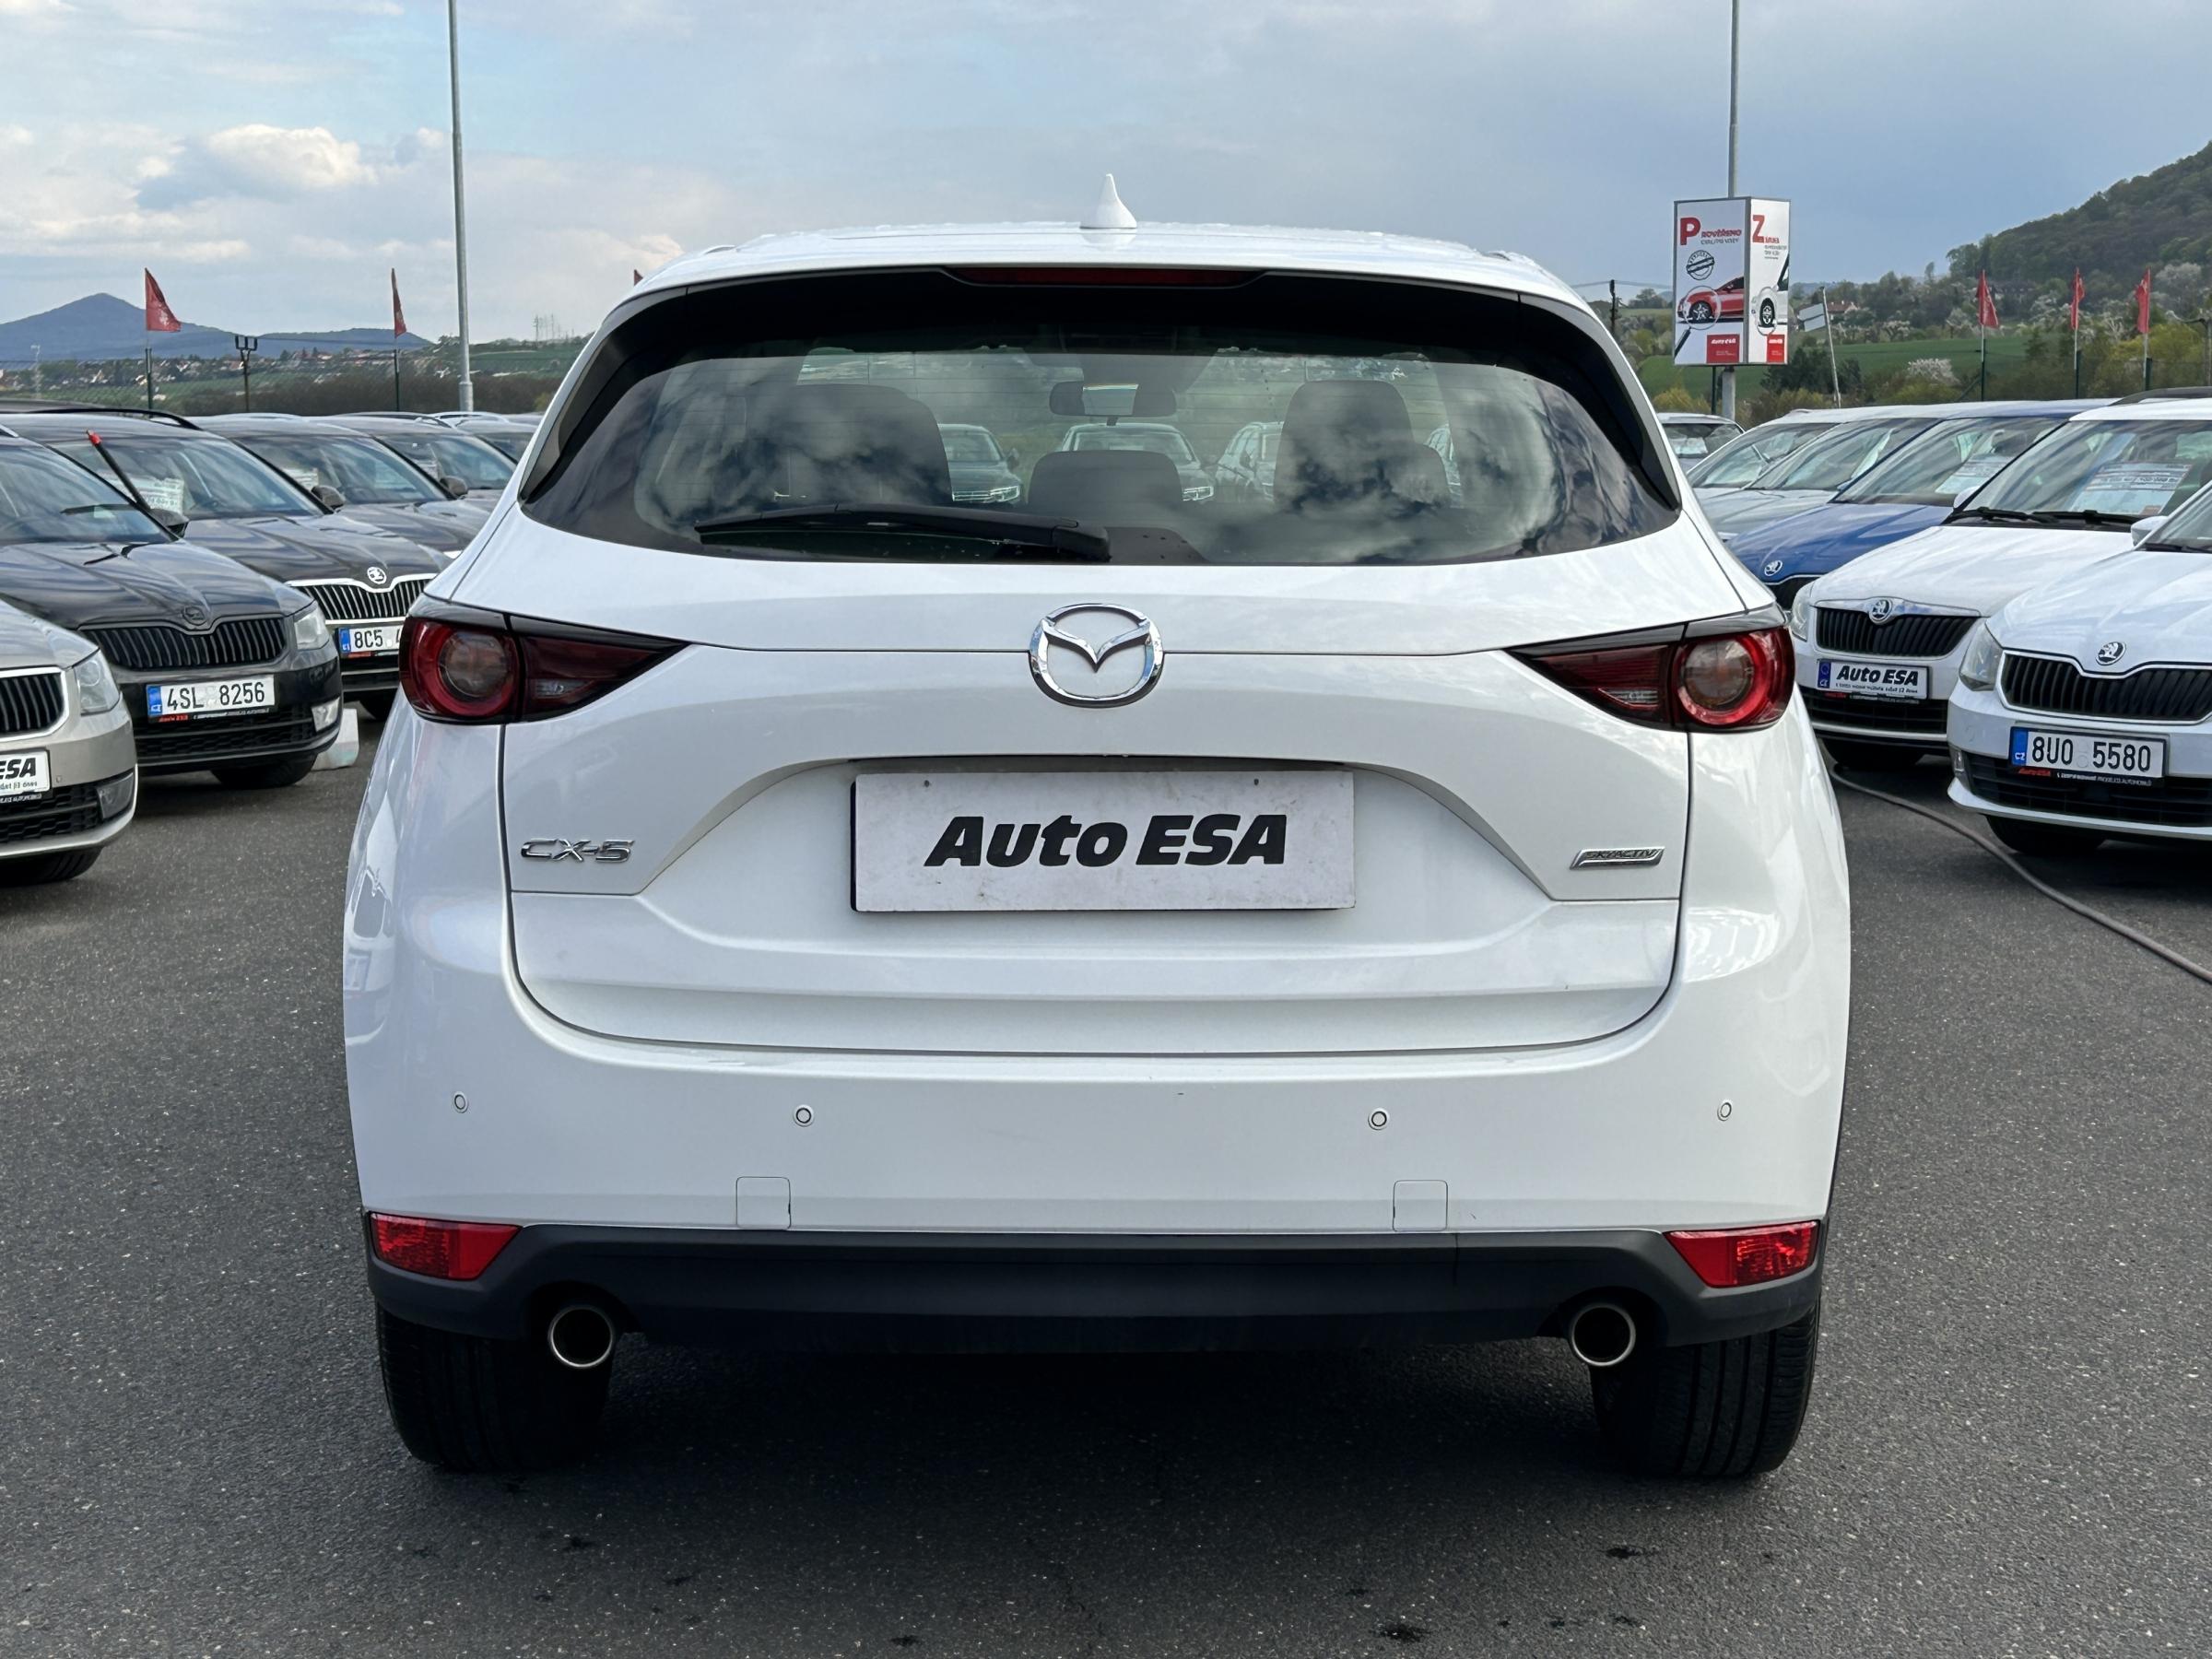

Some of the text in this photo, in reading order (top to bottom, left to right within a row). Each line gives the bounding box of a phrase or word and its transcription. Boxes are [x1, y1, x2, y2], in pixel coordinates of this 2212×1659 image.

[354, 629, 383, 649] 8C5
[1836, 665, 1919, 686] Auto ESA
[167, 681, 265, 711] 4SL 8256
[2092, 741, 2151, 772] 5580
[521, 839, 635, 863] CX-5
[924, 814, 1288, 867] Auto ESA
